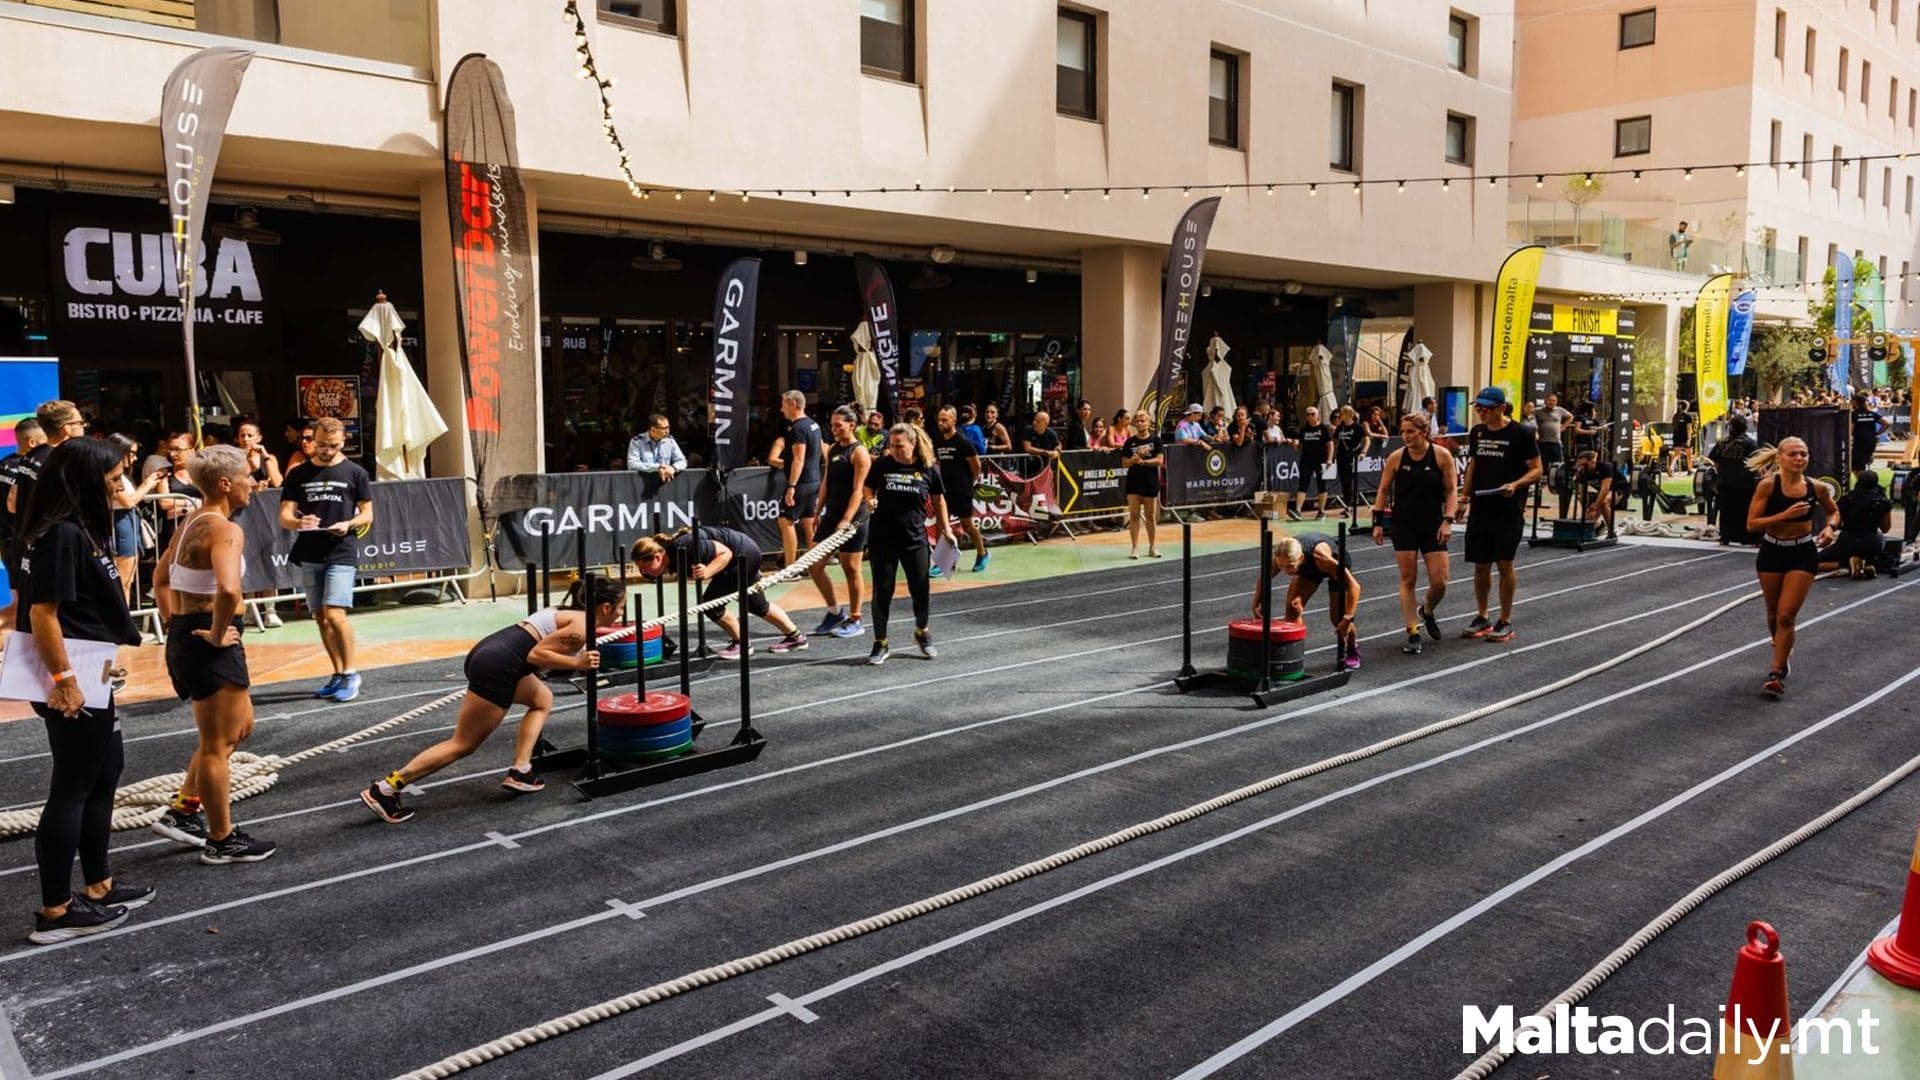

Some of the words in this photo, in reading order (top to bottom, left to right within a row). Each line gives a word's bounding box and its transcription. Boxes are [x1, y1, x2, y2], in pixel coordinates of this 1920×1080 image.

[486, 160, 513, 257] mindsets
[68, 302, 130, 320] BISTRO
[224, 309, 263, 325] CAFE
[503, 261, 524, 351] Evolving
[1170, 219, 1197, 380] WAREHOUSE
[1499, 277, 1518, 369] hospicemalta
[1573, 308, 1600, 333] FINISH
[714, 278, 744, 445] GARMIN
[886, 484, 920, 494] GARMIN
[1186, 477, 1245, 489] WAREHOUSE
[972, 515, 1002, 530] BOX
